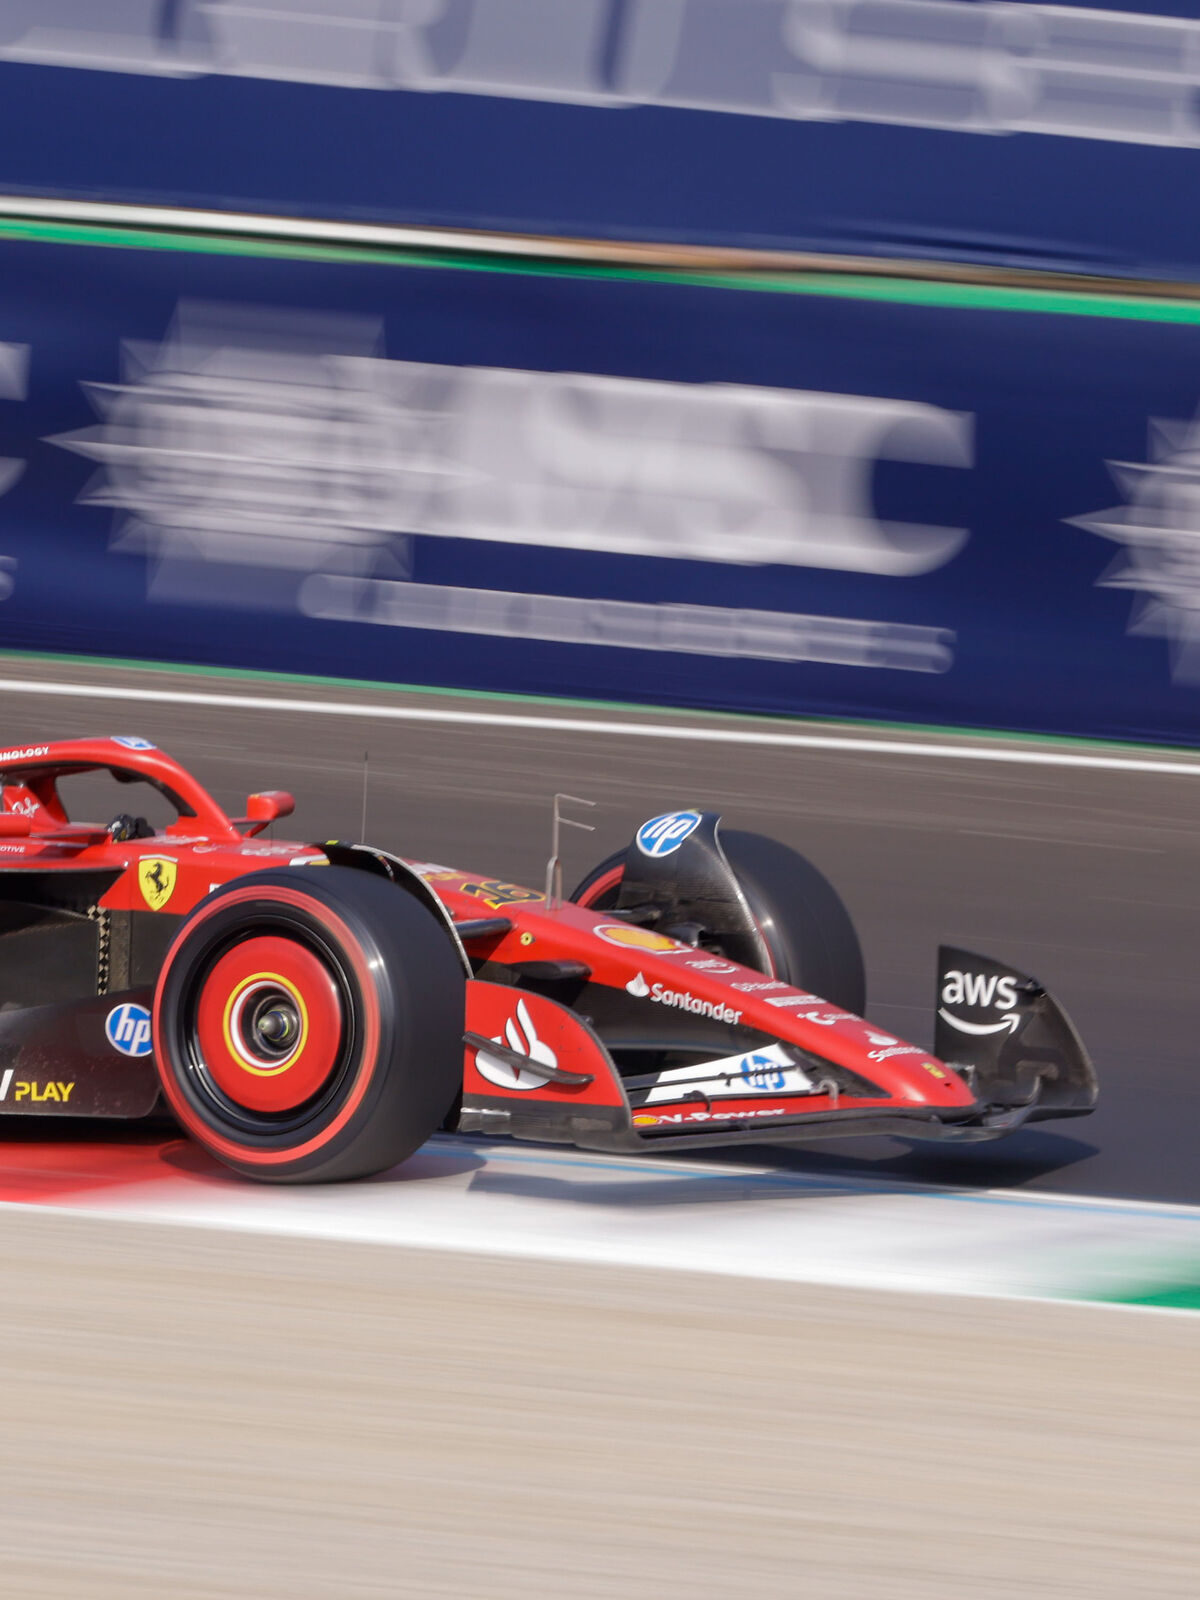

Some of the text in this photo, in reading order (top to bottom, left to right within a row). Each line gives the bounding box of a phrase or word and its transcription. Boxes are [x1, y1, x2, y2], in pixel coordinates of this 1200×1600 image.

[640, 816, 695, 854] hp
[651, 983, 743, 1025] Santander
[942, 970, 1018, 1010] aws
[114, 1005, 151, 1055] hp
[15, 1081, 75, 1102] PLAY
[745, 1056, 785, 1090] hp
[660, 1108, 786, 1124] V-Power
